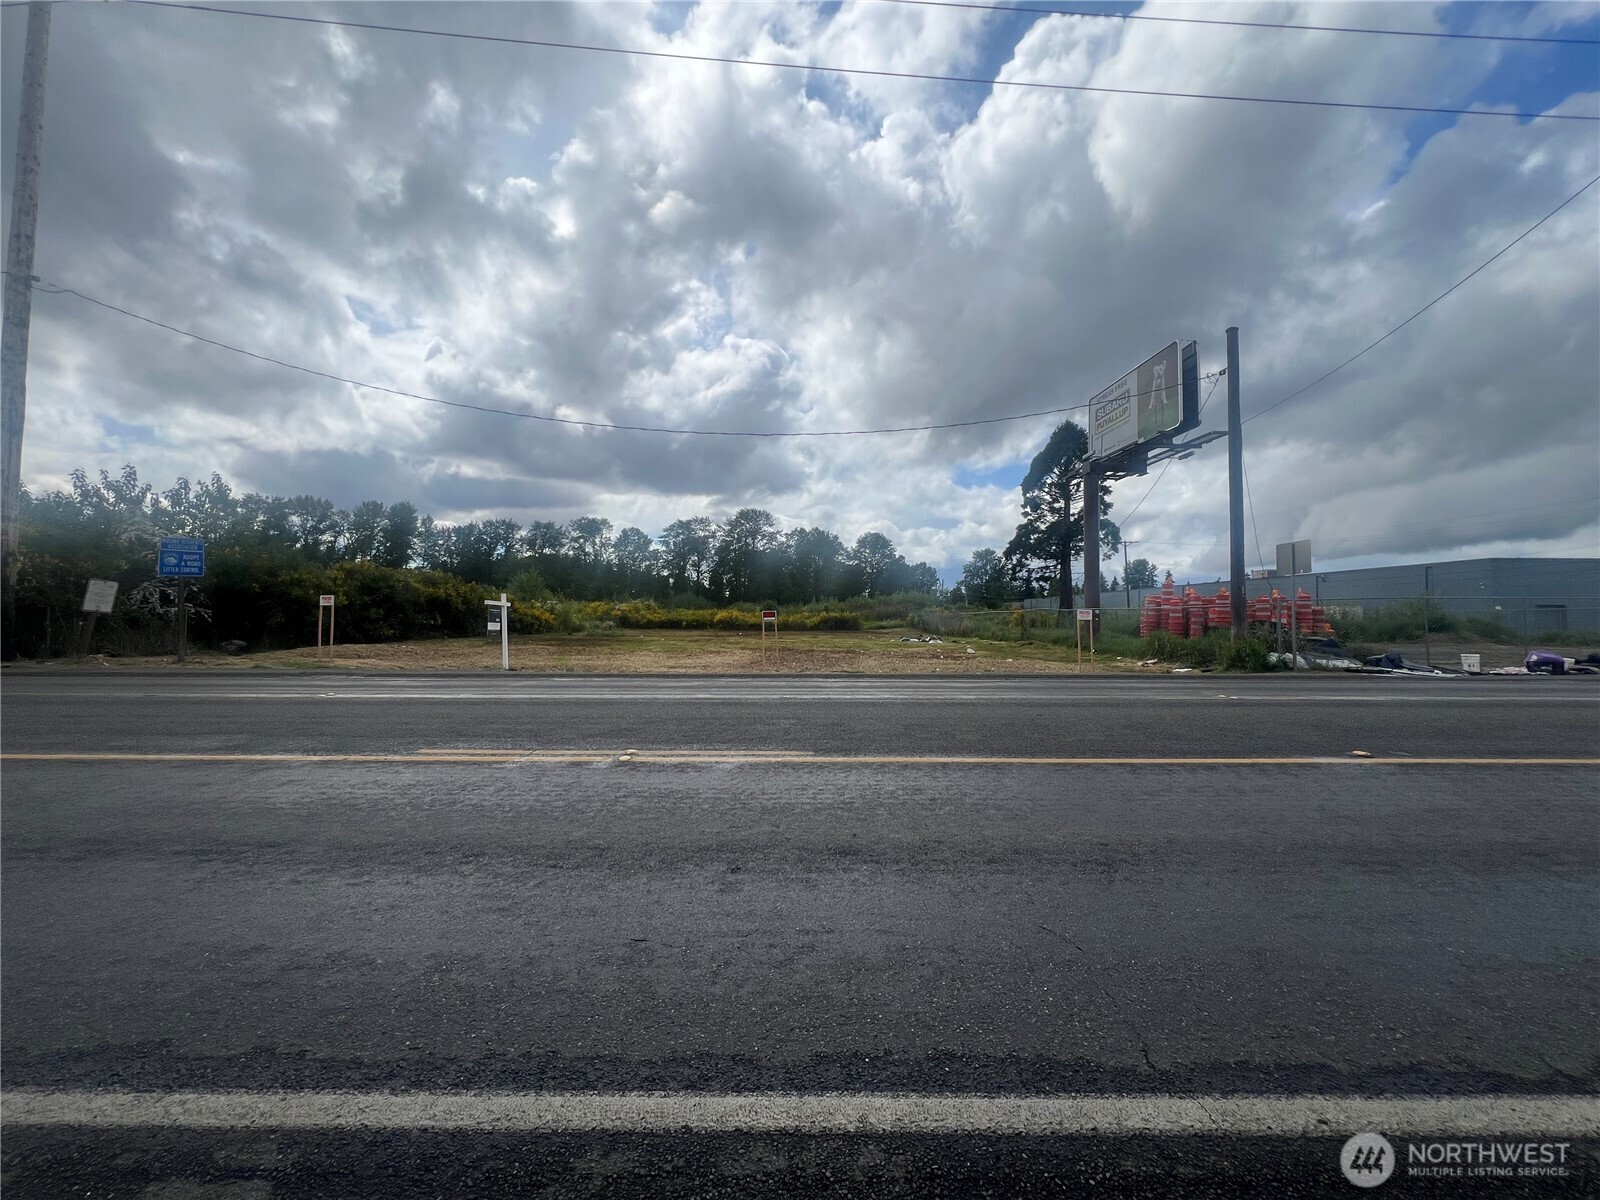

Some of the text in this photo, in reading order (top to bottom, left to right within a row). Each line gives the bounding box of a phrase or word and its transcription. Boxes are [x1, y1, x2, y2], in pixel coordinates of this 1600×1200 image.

[1114, 378, 1128, 392] FREE
[1097, 393, 1128, 419] SUBARU
[1097, 406, 1128, 430] PUYALLUP
